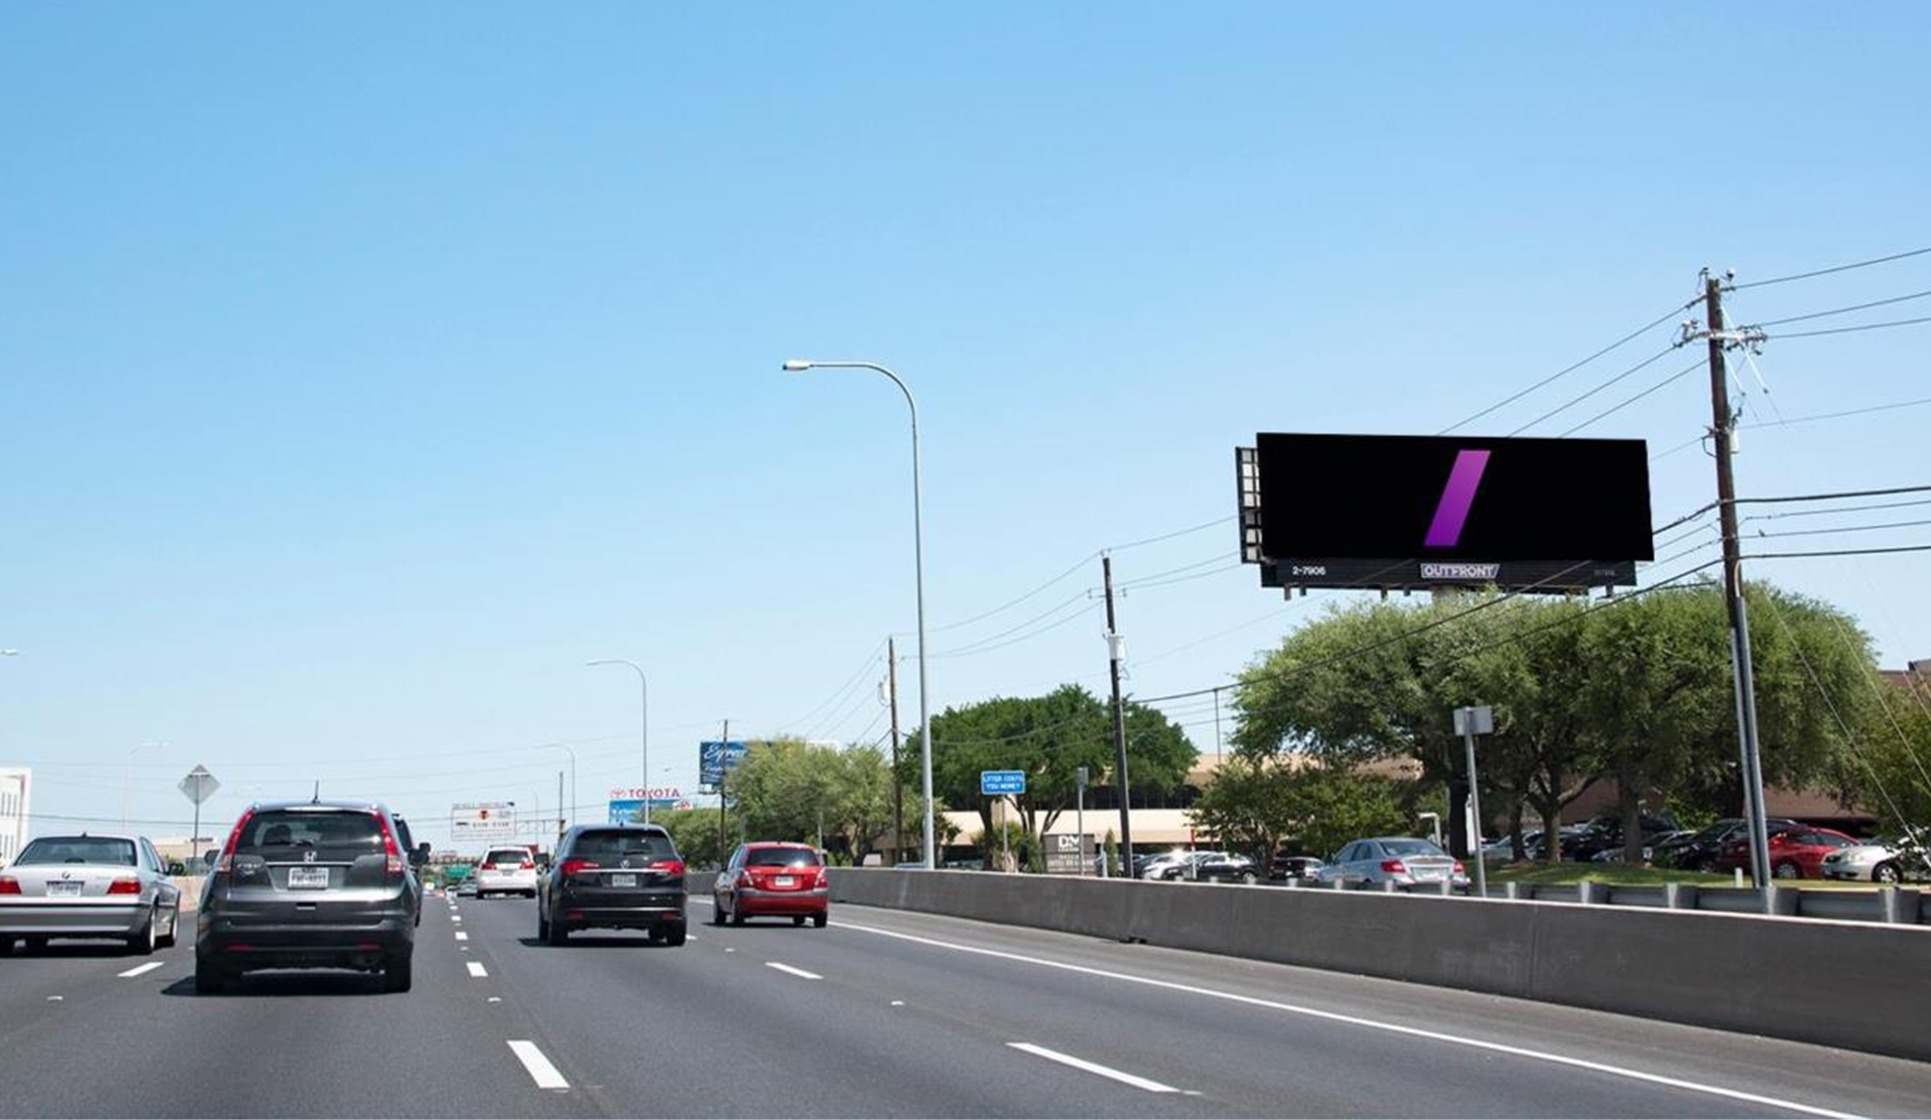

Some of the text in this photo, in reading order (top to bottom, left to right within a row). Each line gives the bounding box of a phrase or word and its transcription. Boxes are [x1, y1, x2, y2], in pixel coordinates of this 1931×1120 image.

[1292, 566, 1327, 576] 2-7906
[1423, 564, 1496, 578] OUTFRONT
[629, 788, 680, 798] TOYOTA
